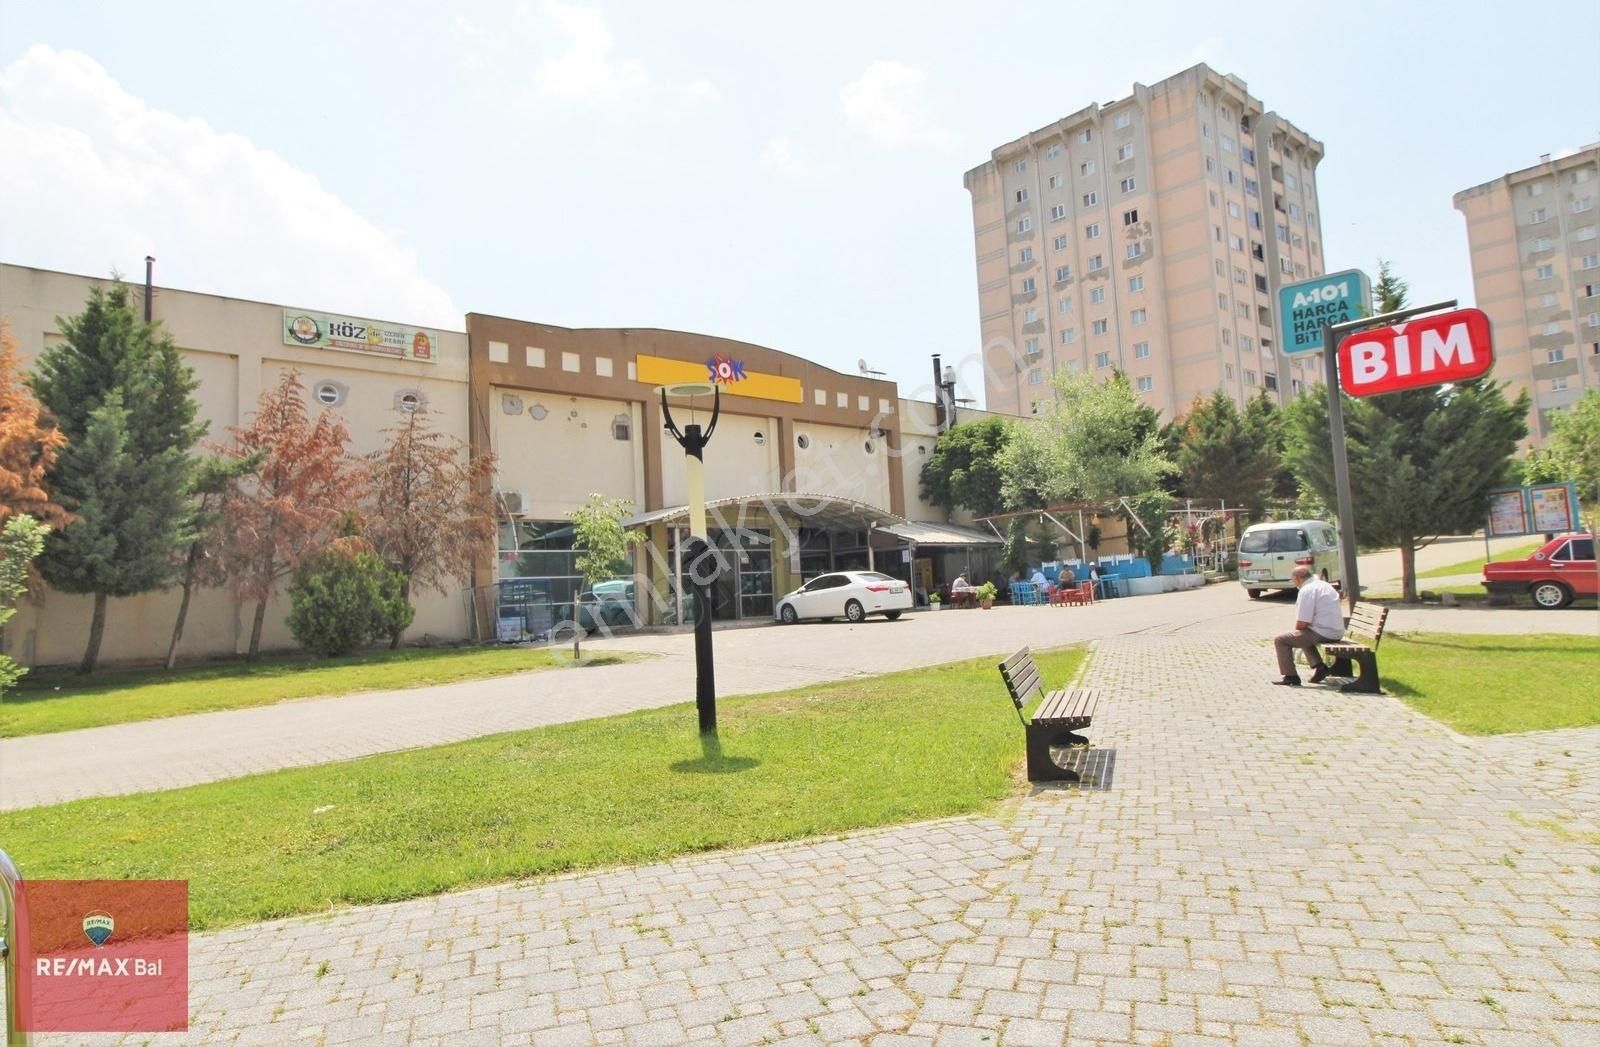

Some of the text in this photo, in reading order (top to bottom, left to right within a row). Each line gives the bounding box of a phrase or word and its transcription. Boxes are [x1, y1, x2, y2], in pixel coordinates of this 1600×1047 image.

[1293, 300, 1349, 320] HARCA
[329, 321, 366, 340] KÖZ
[1294, 312, 1350, 333] HARCA
[1350, 322, 1475, 385] BİM
